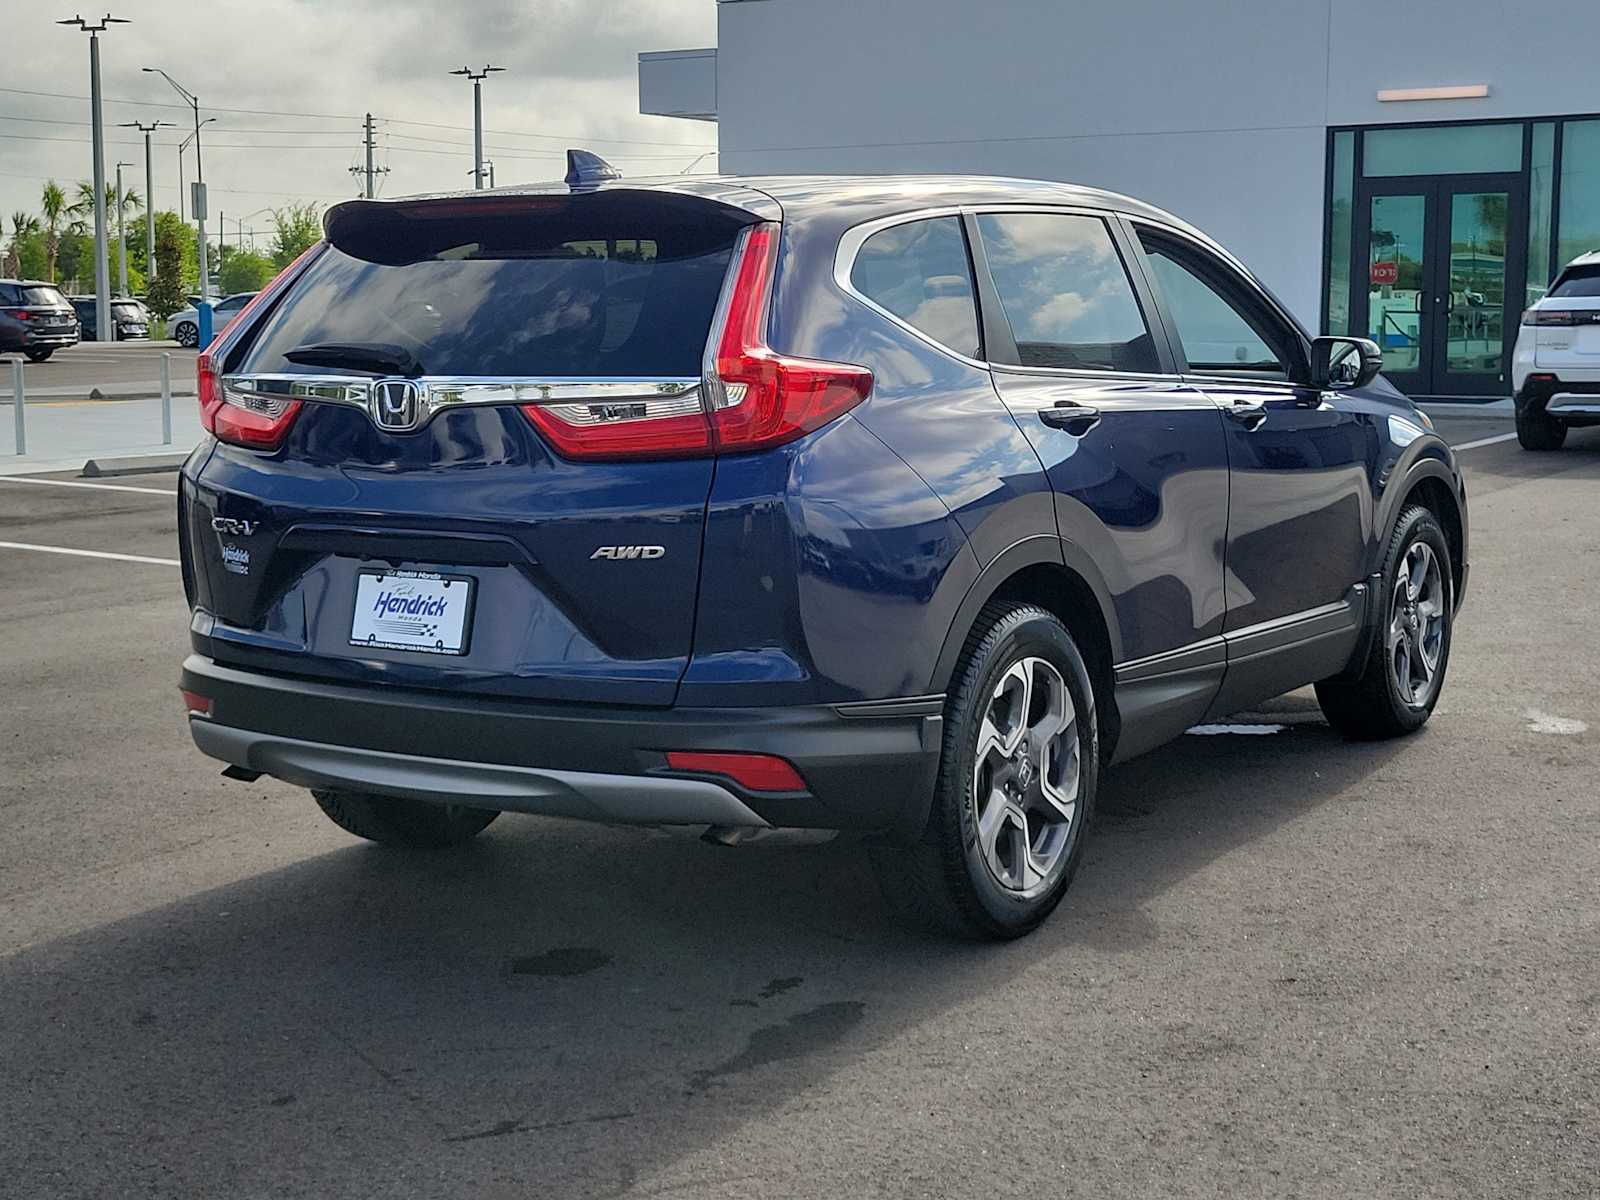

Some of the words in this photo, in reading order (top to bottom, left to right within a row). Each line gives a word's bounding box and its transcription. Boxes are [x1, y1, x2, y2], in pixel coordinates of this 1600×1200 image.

[211, 516, 261, 536] CR-V
[590, 545, 665, 560] AWD
[373, 591, 448, 618] Hendrick
